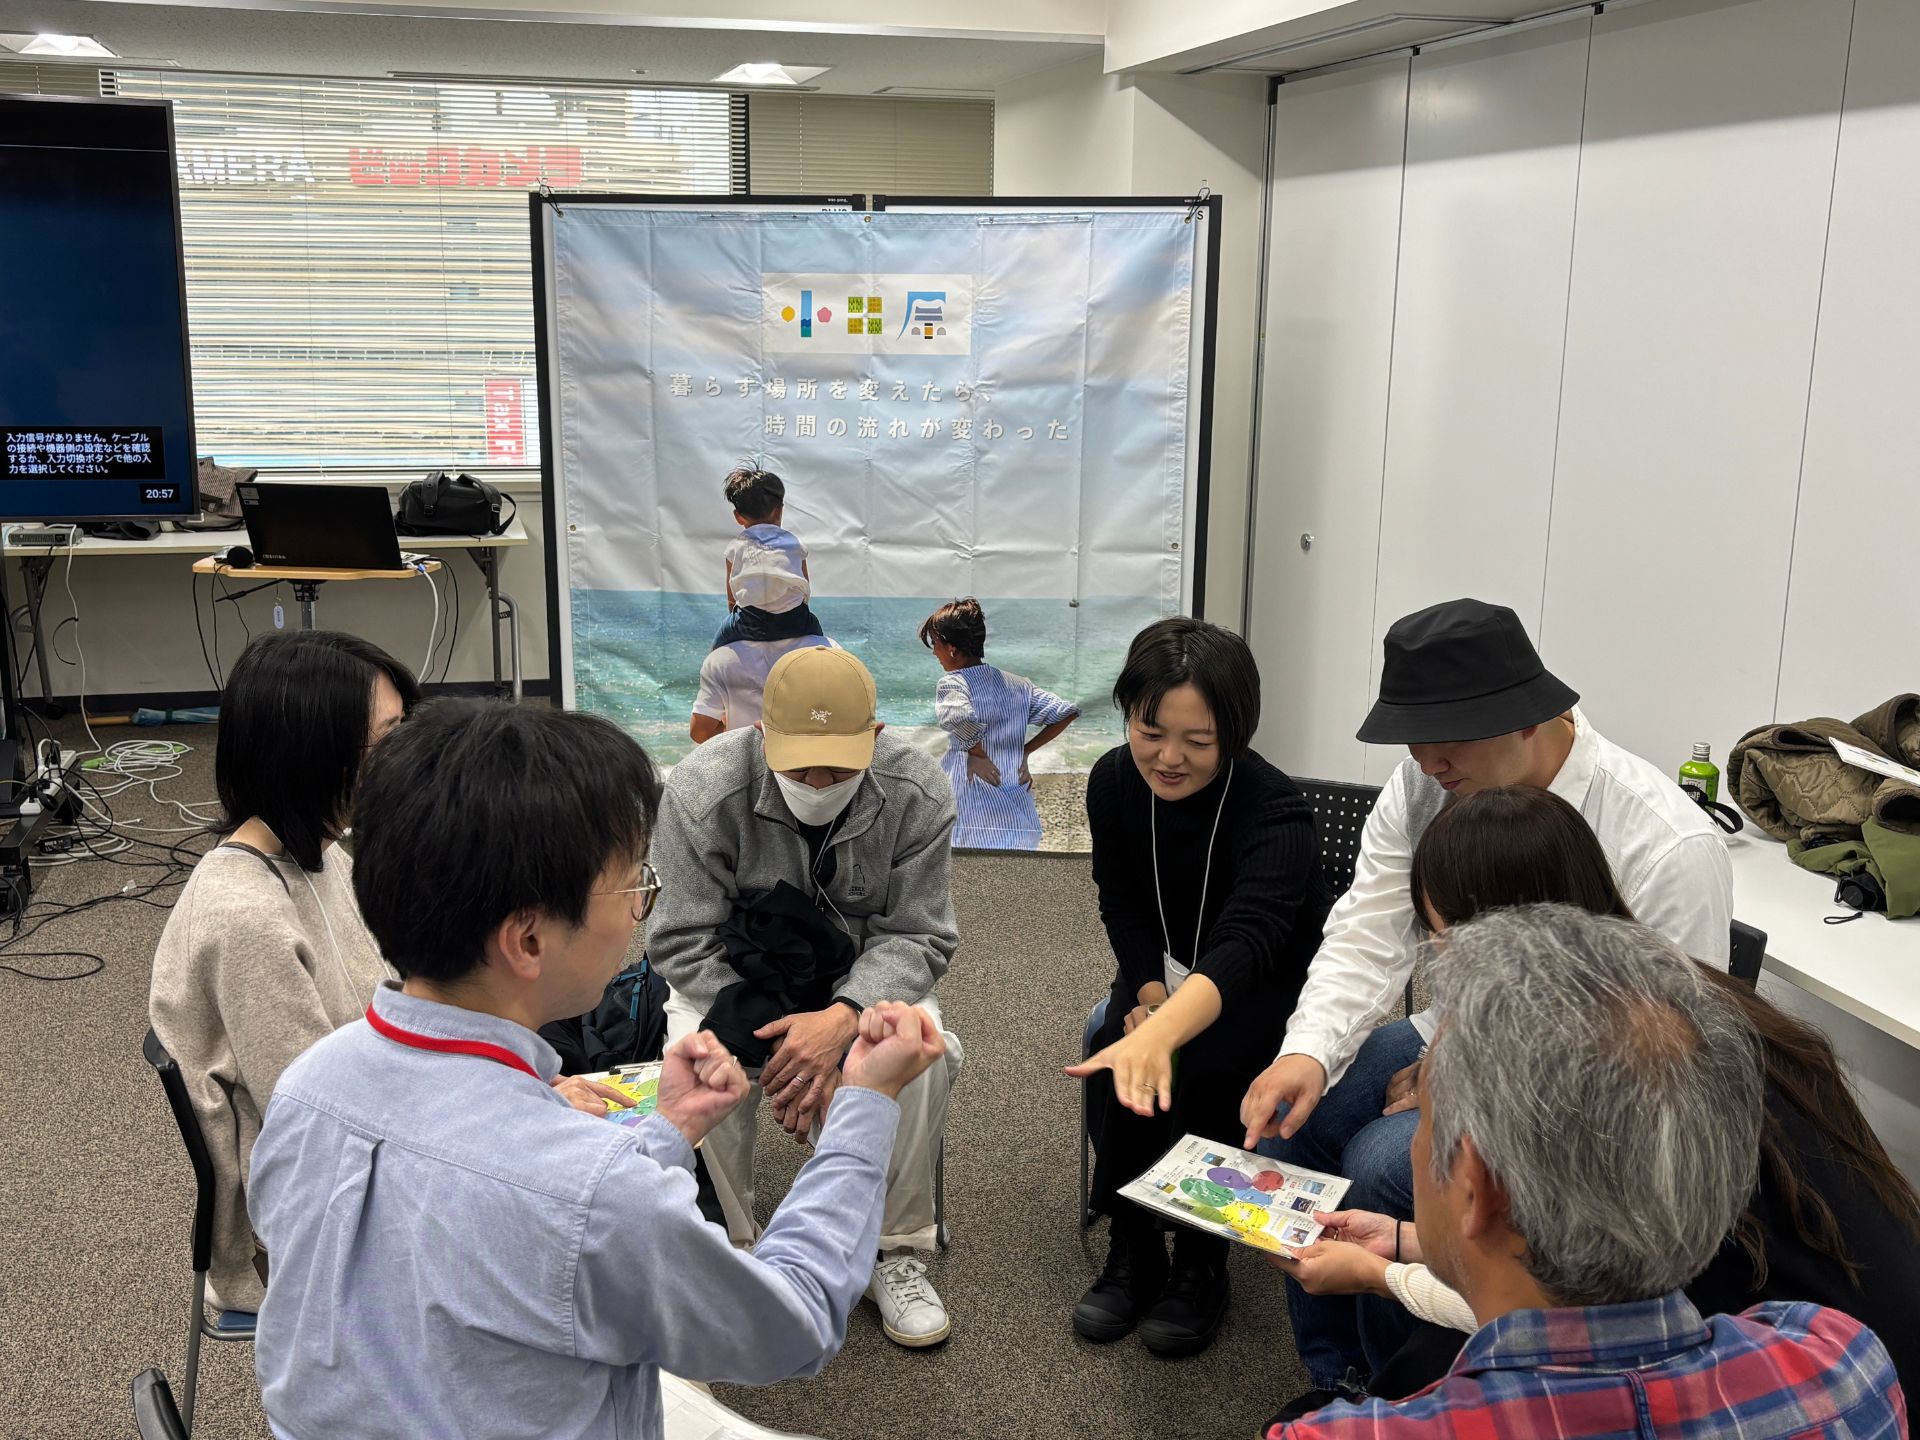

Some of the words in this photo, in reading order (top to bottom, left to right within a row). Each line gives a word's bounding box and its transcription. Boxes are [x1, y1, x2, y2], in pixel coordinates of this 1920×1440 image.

[780, 290, 947, 341] 小田原
[669, 374, 992, 403] 暮らす場所を変えたら、
[764, 415, 1069, 440] 時間の流れが変わった
[9, 464, 109, 474] 力を選択してください。
[146, 489, 174, 499] 20:57
